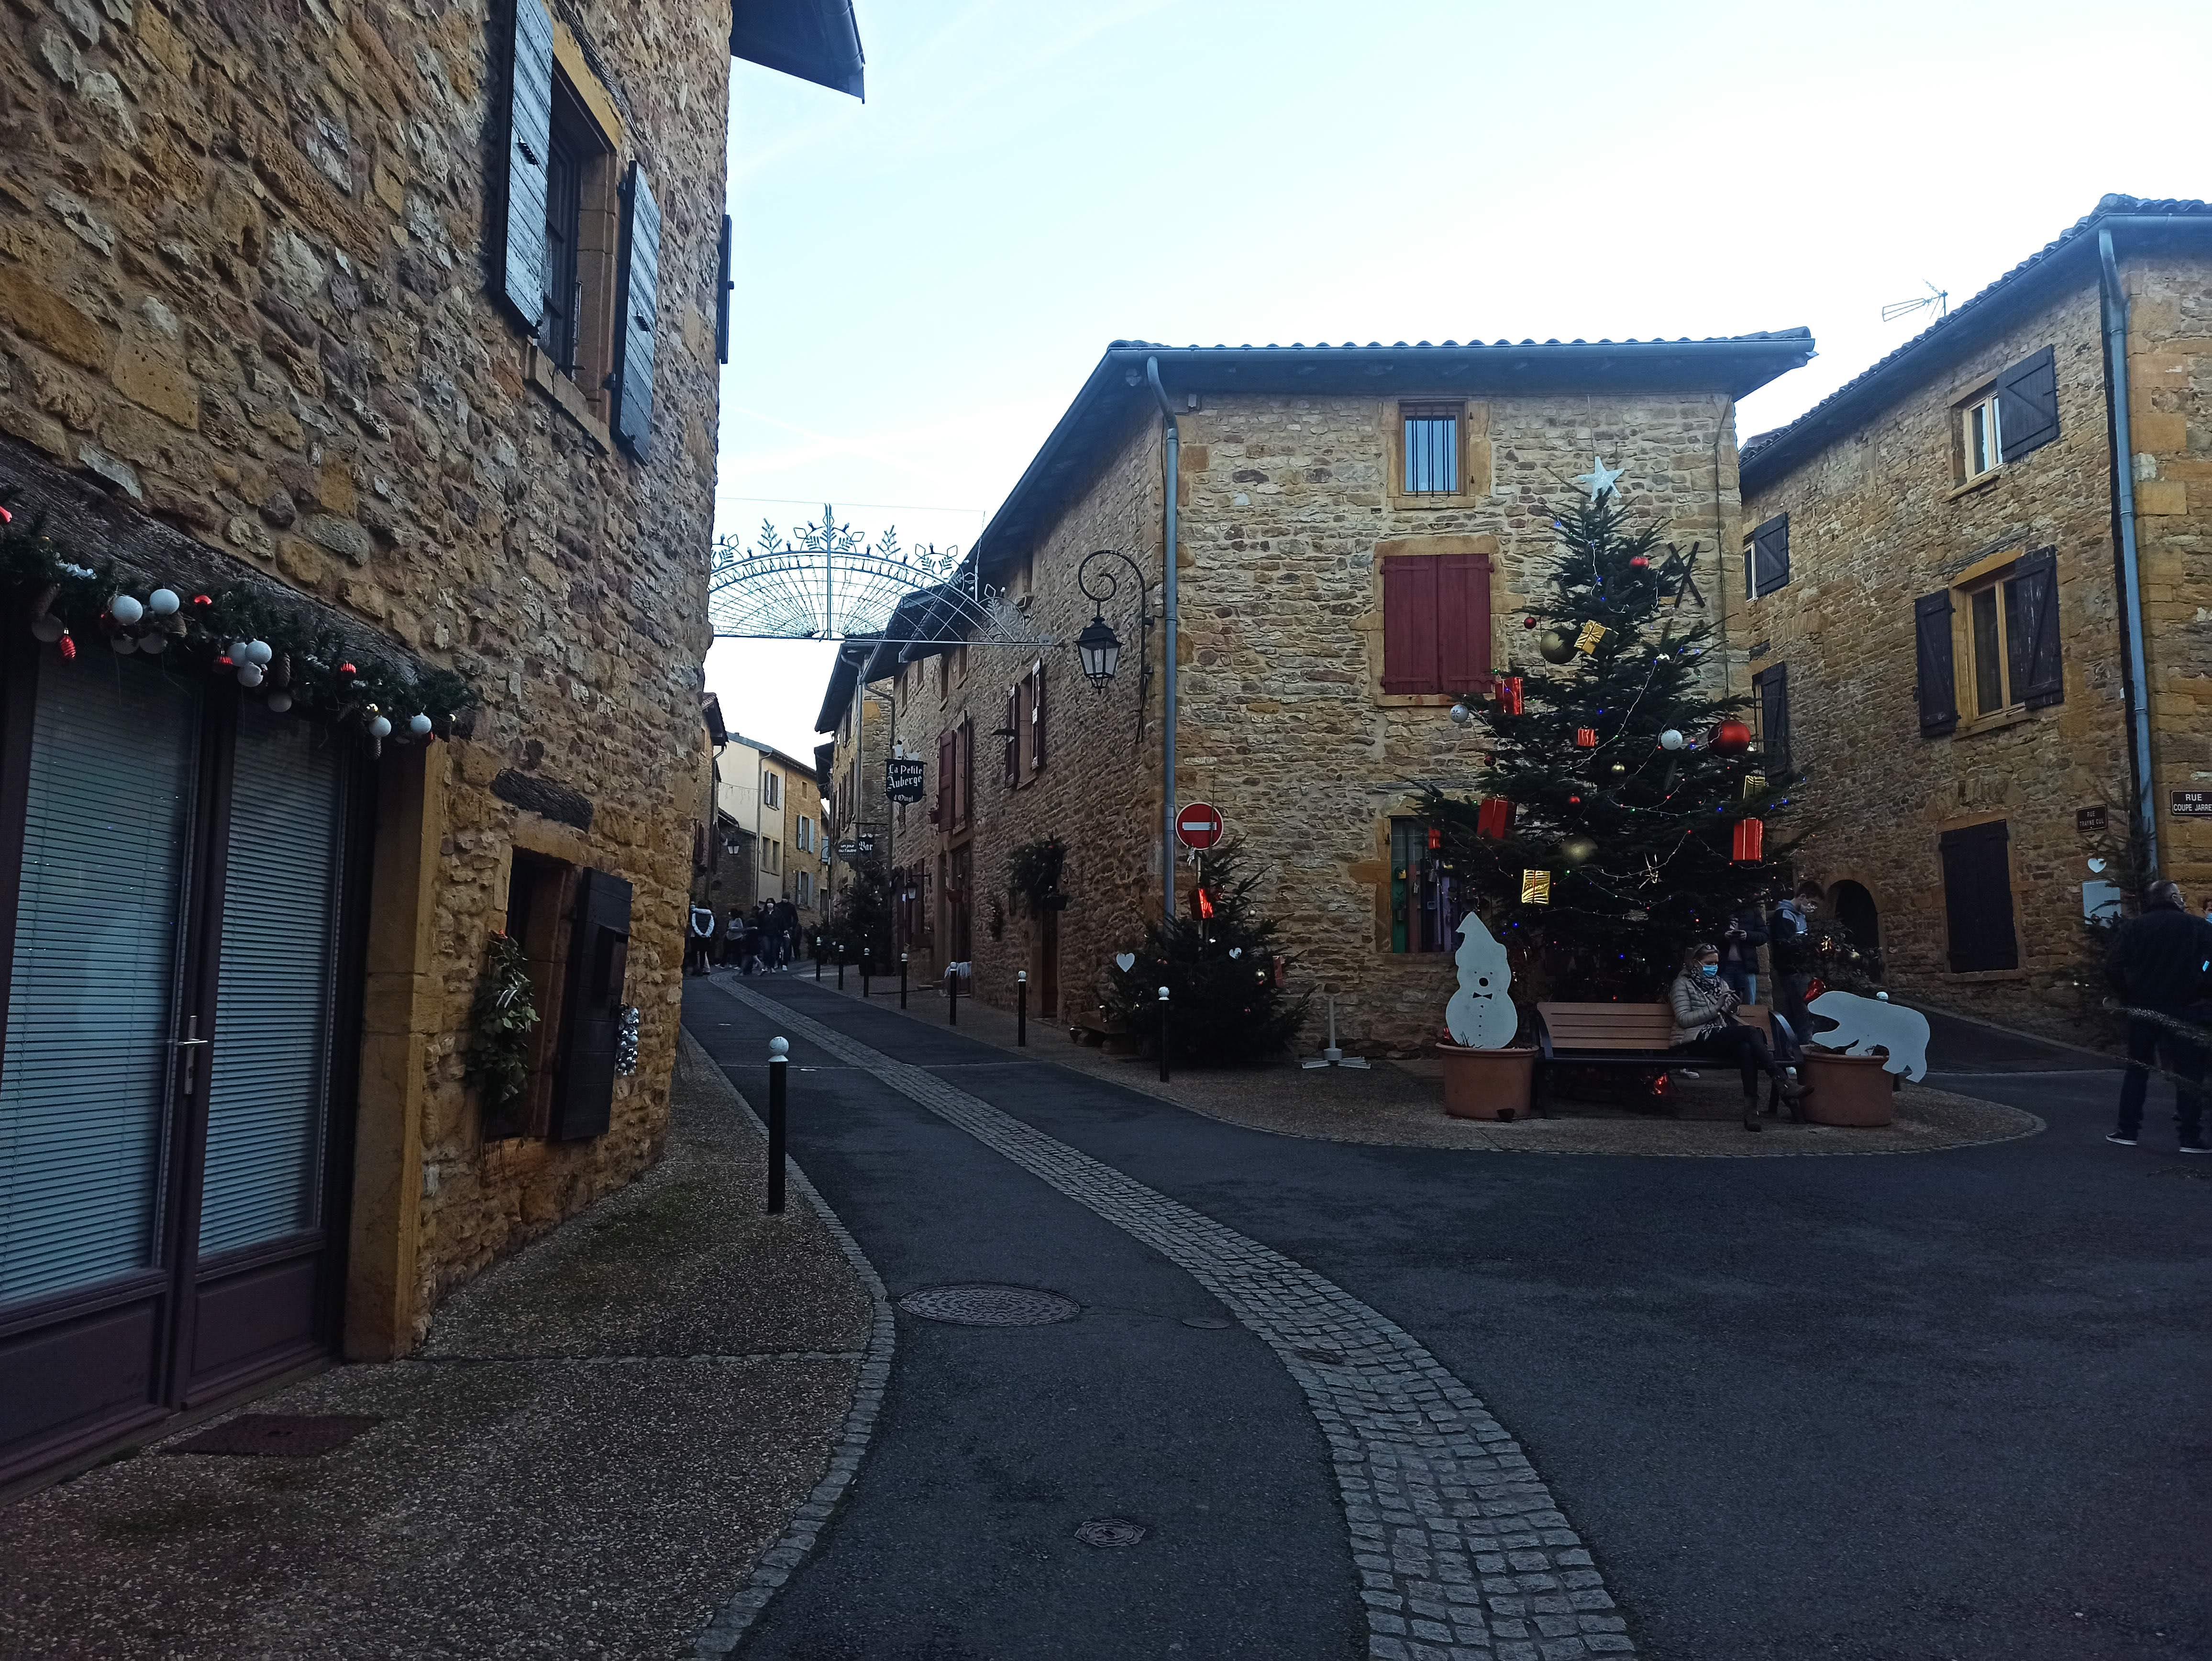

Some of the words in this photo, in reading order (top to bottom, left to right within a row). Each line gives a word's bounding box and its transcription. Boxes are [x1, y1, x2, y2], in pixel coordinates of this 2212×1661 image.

[888, 764, 898, 775] La
[900, 764, 922, 775] Petite
[886, 775, 922, 791] Auberge
[859, 841, 873, 851] Bar
